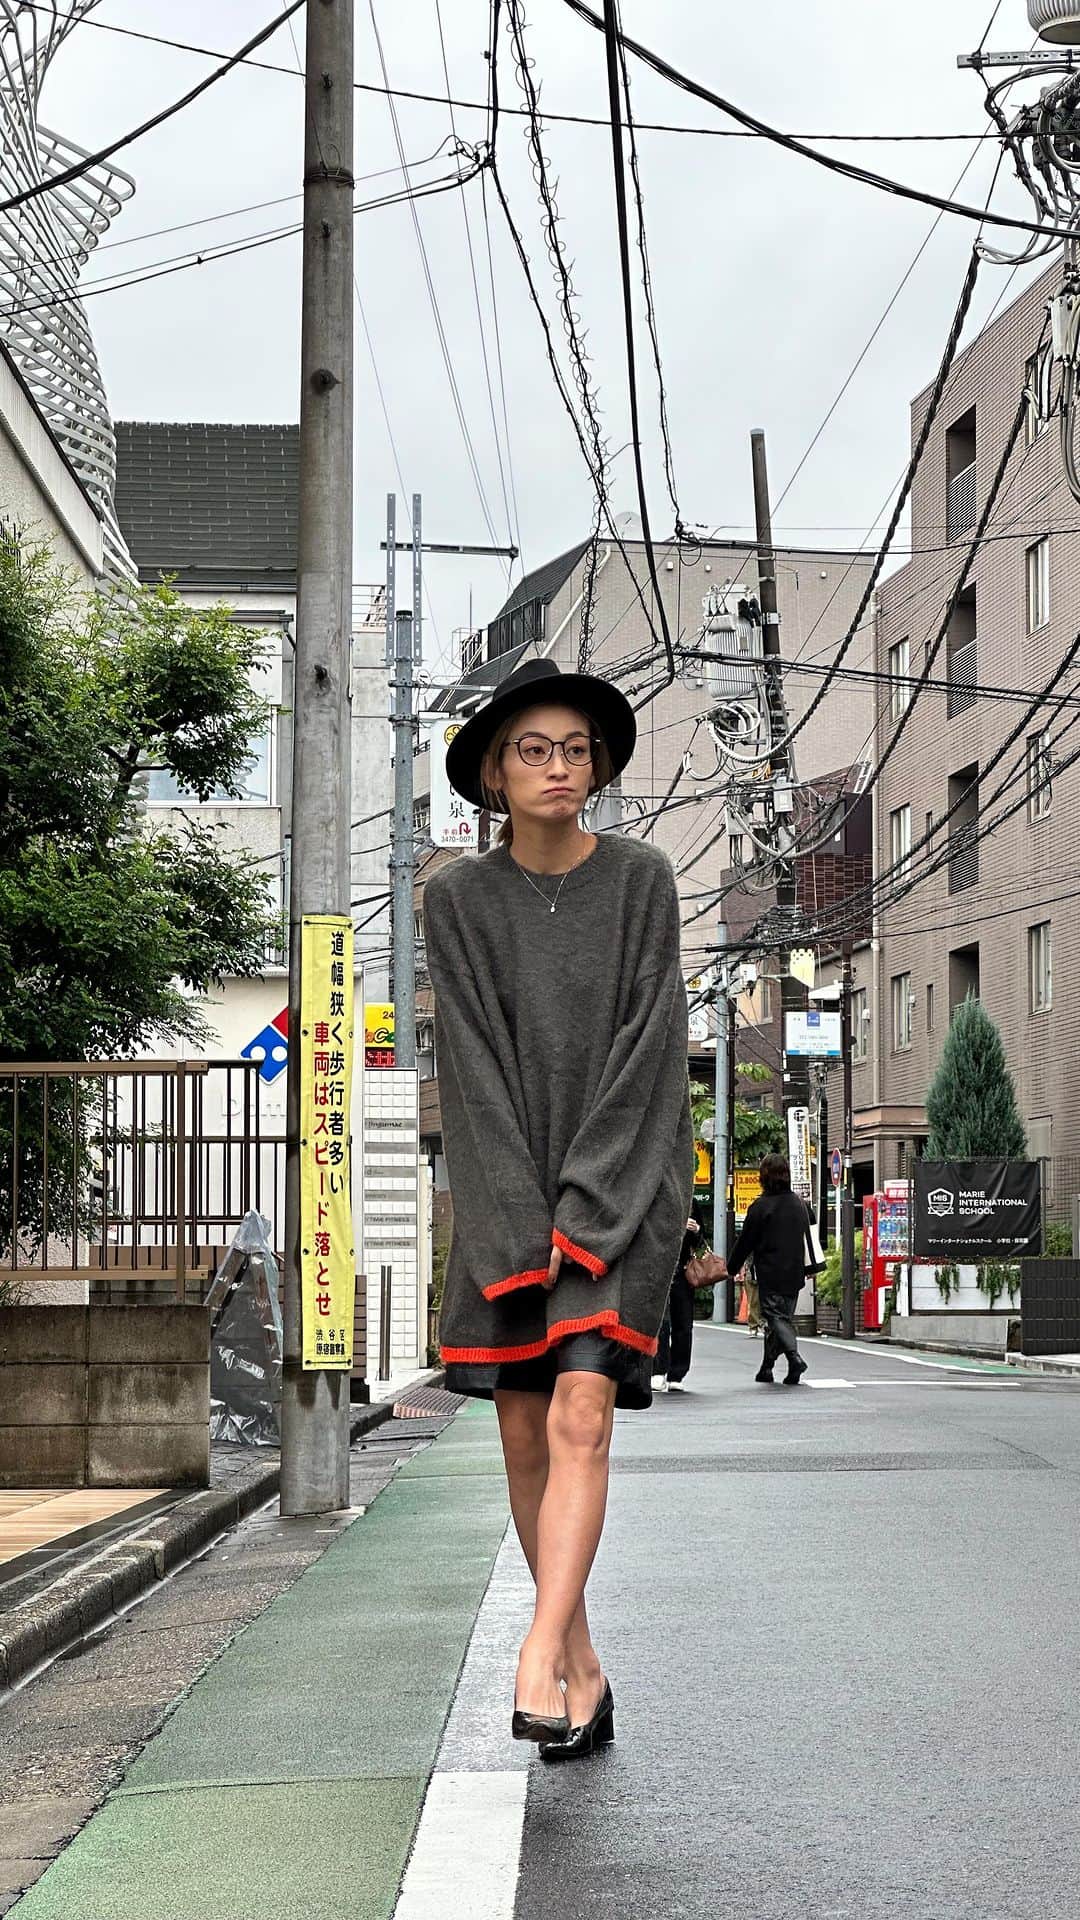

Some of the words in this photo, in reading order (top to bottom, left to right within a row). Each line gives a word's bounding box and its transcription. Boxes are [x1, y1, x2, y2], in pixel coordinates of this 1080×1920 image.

[313, 1020, 331, 1316] 車両はスピード落とせ
[328, 931, 345, 1194] 道幅狭く歩行者多い
[959, 1190, 986, 1198] MARIE
